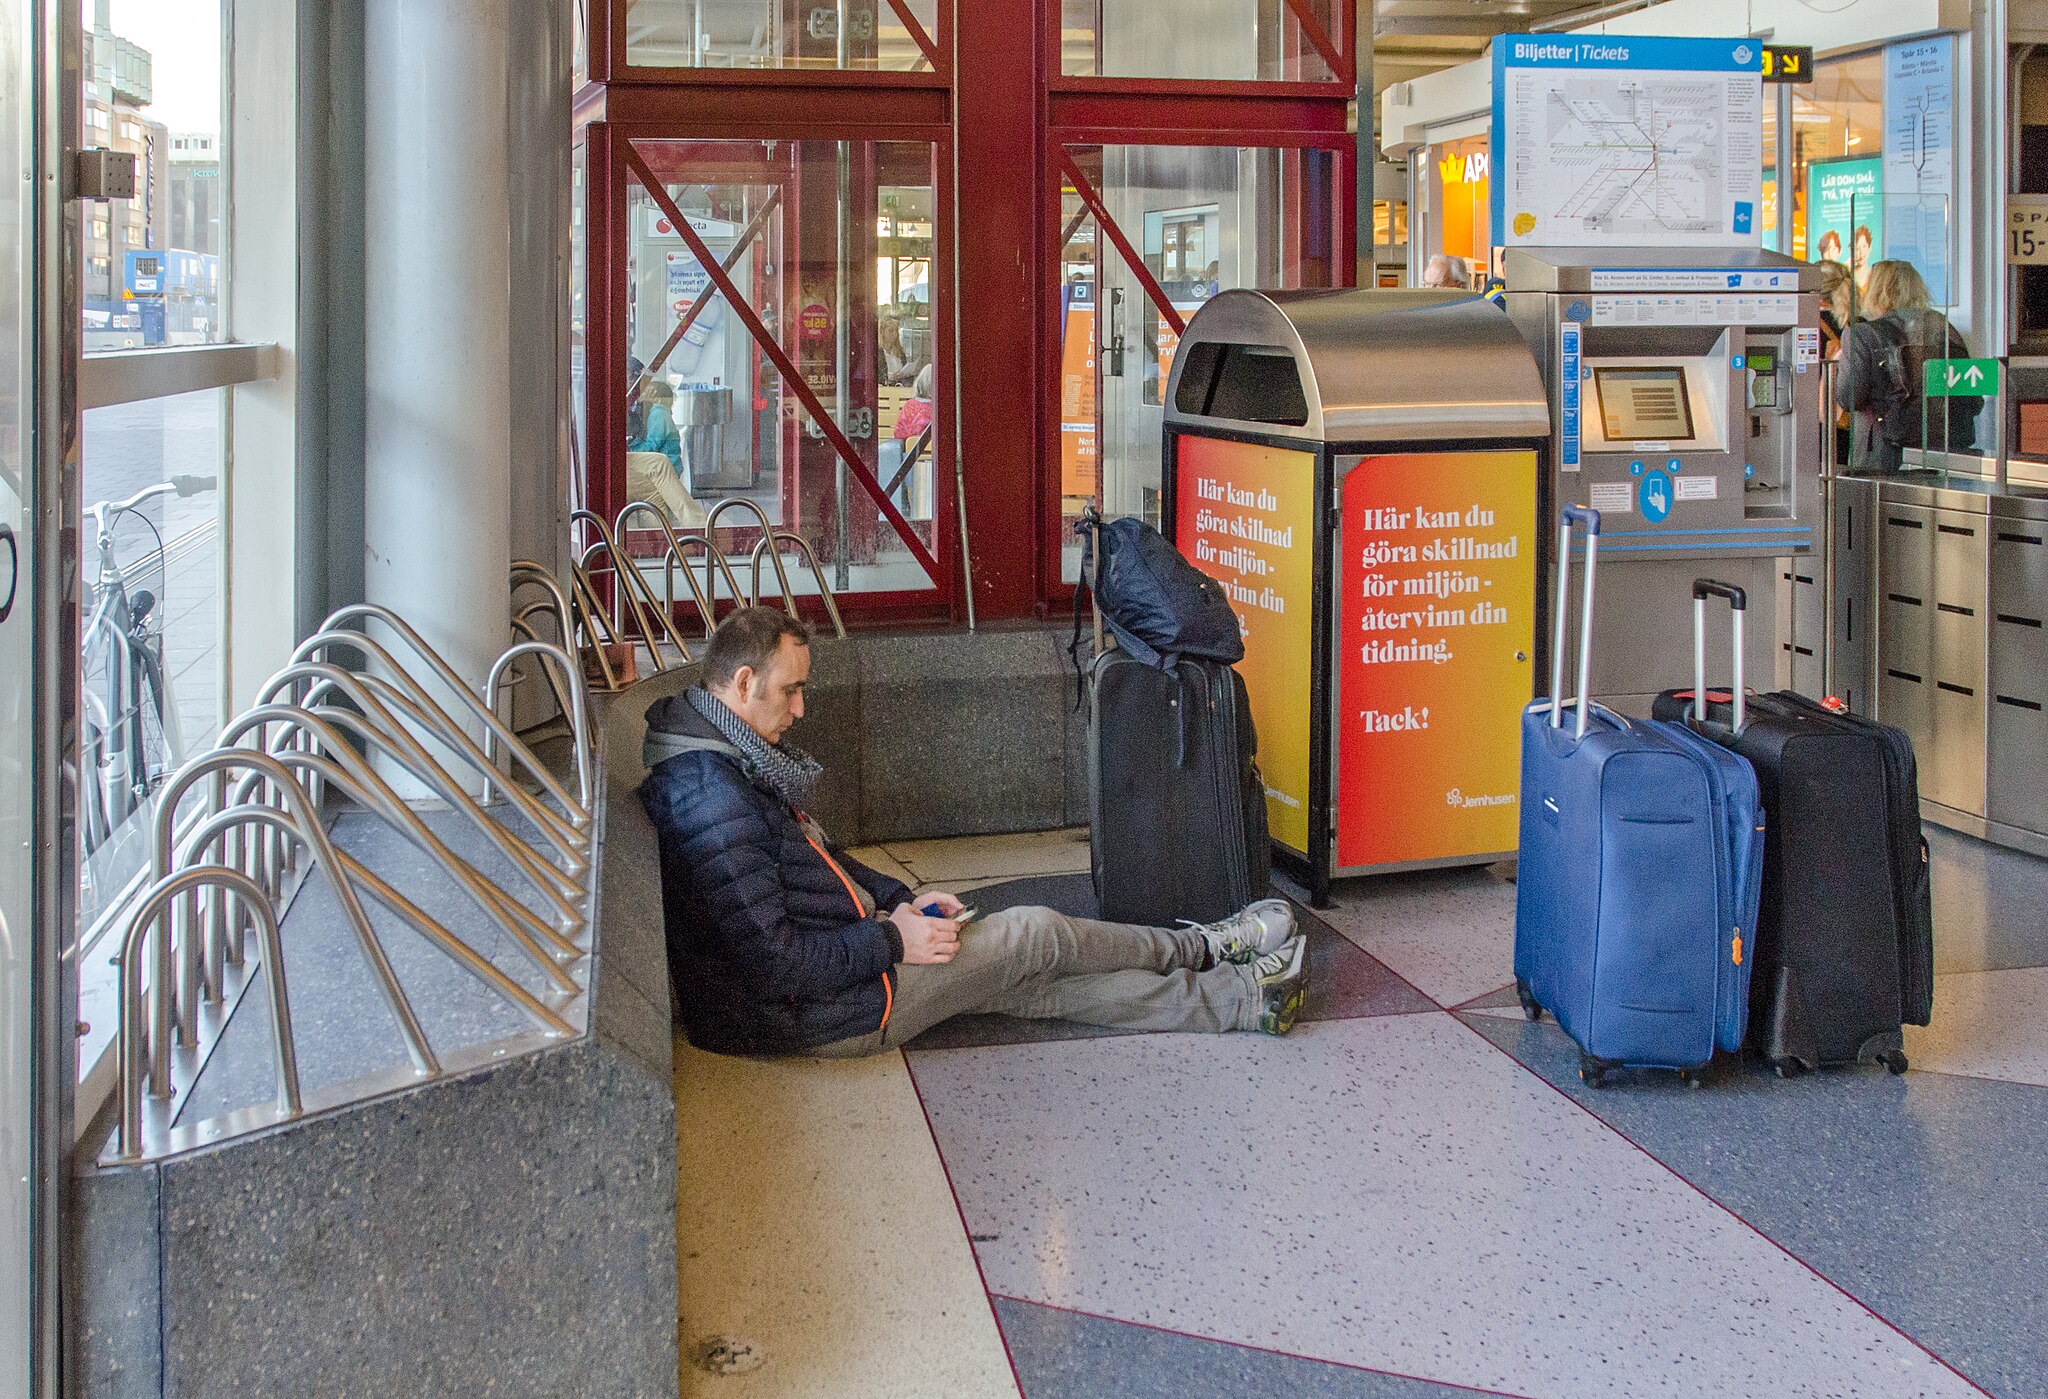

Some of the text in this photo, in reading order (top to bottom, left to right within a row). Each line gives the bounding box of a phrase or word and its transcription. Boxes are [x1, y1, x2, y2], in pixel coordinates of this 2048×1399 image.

[1514, 43, 1629, 62] Biljetter Tickets
[1916, 48, 1924, 56] 15
[1836, 174, 1856, 187] DOM
[1196, 478, 1277, 512] Här kan du
[1196, 508, 1292, 549] göra skillnad
[1364, 504, 1495, 531] Här kan du
[1196, 538, 1217, 563] för
[1219, 546, 1266, 576] miljön
[1362, 536, 1518, 569] göra skillnad
[1362, 573, 1398, 598] för
[1403, 570, 1479, 600] miljön
[1260, 586, 1284, 614] din
[1361, 601, 1508, 631] återvinn din
[1360, 637, 1454, 665] tidning.
[1360, 706, 1429, 733] Tack!
[1462, 794, 1516, 808] Jernhusen
